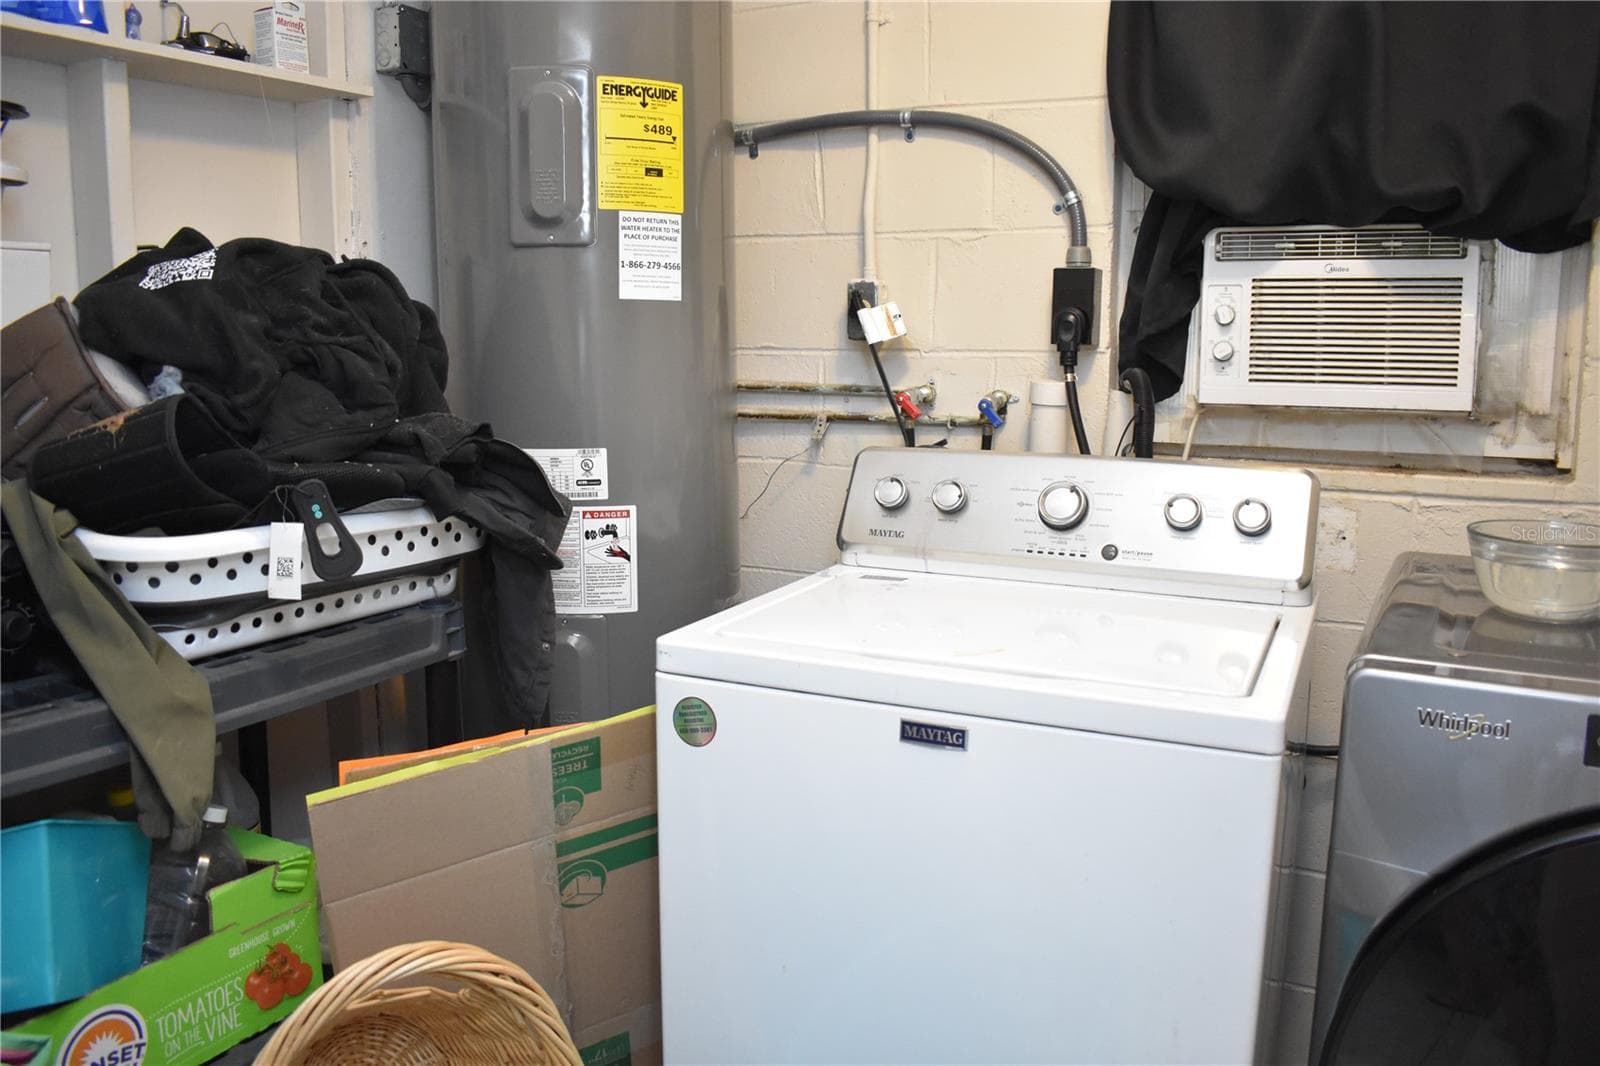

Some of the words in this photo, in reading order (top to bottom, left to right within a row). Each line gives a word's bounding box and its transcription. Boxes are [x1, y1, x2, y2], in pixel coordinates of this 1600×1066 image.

[602, 83, 678, 102] ENERGYGUIDE
[643, 124, 673, 136] $489
[620, 260, 681, 271] 1-866-279-4566
[593, 511, 629, 519] DANGER
[868, 528, 905, 538] MAYTAG
[1417, 706, 1512, 740] Whirlpool
[903, 724, 964, 745] MAYTAG
[228, 931, 270, 959] GREENHOUSE
[272, 918, 296, 937] GROWN
[156, 976, 244, 1042] TOMATOES
[164, 1036, 181, 1057] ON
[184, 1022, 203, 1048] THE
[204, 1003, 243, 1042] VINE
